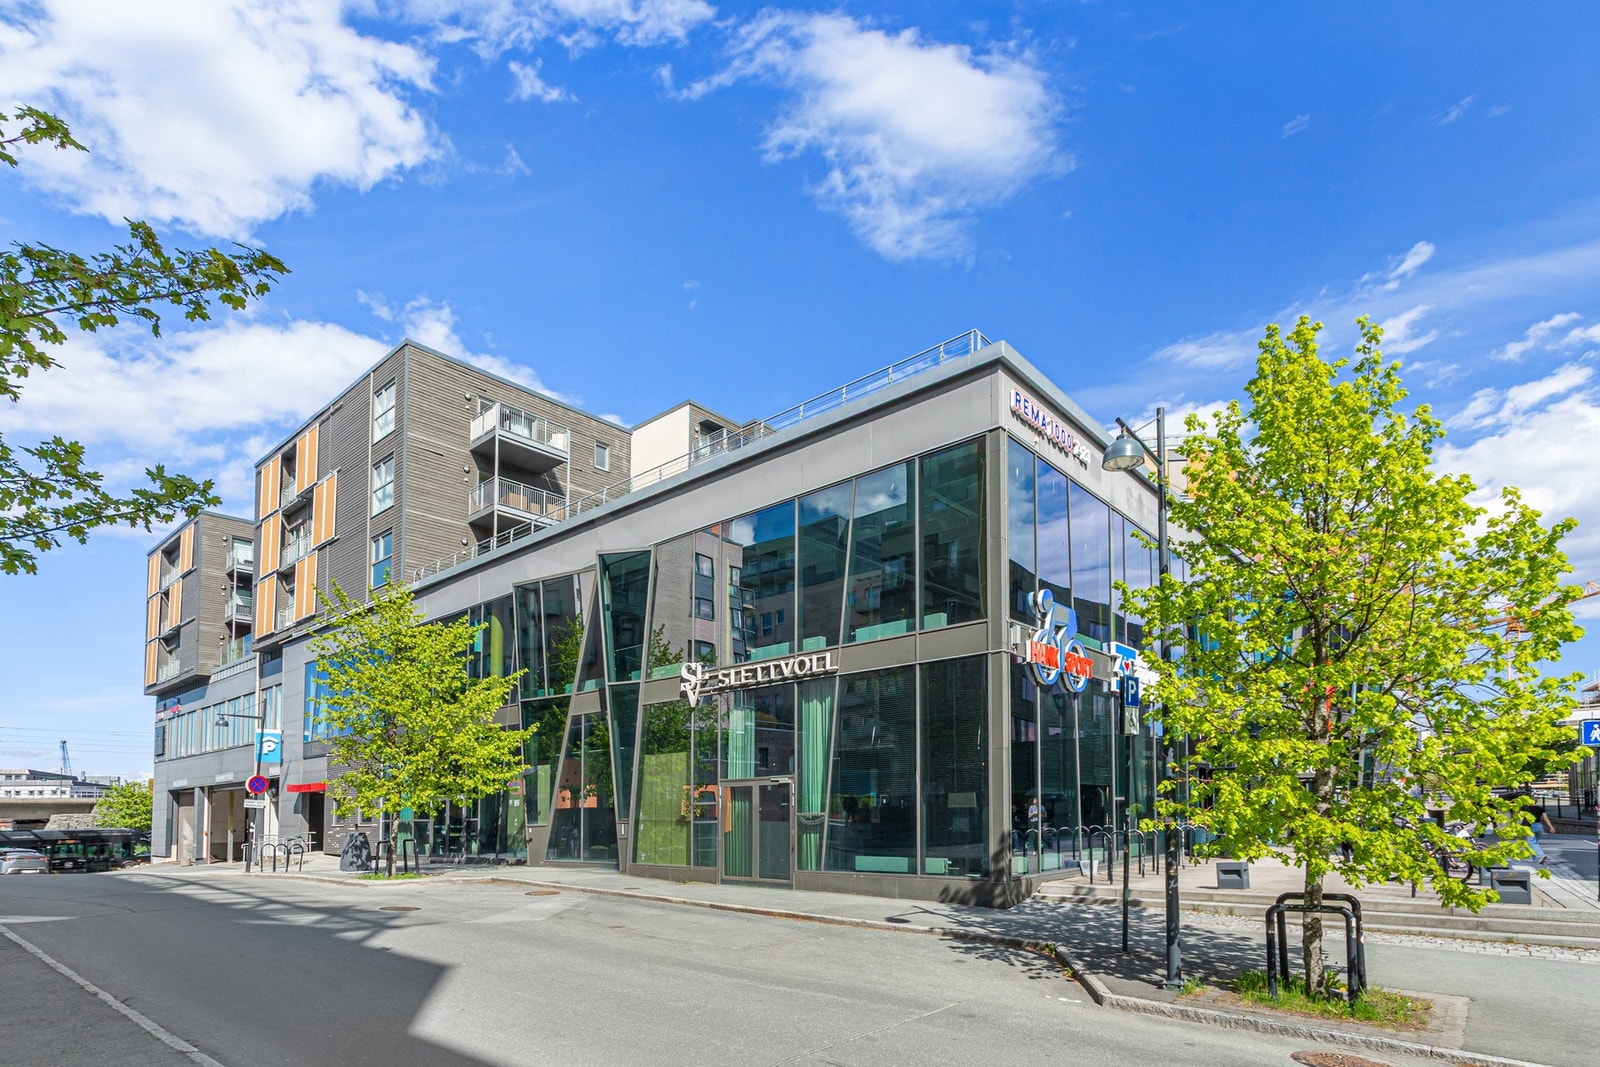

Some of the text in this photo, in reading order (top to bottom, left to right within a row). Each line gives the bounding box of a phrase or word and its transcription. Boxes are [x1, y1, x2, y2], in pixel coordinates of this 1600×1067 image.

[1011, 387, 1047, 431] REMA
[1046, 417, 1075, 453] 1000
[717, 652, 838, 688] SLETTVOLL
[1128, 680, 1137, 703] P
